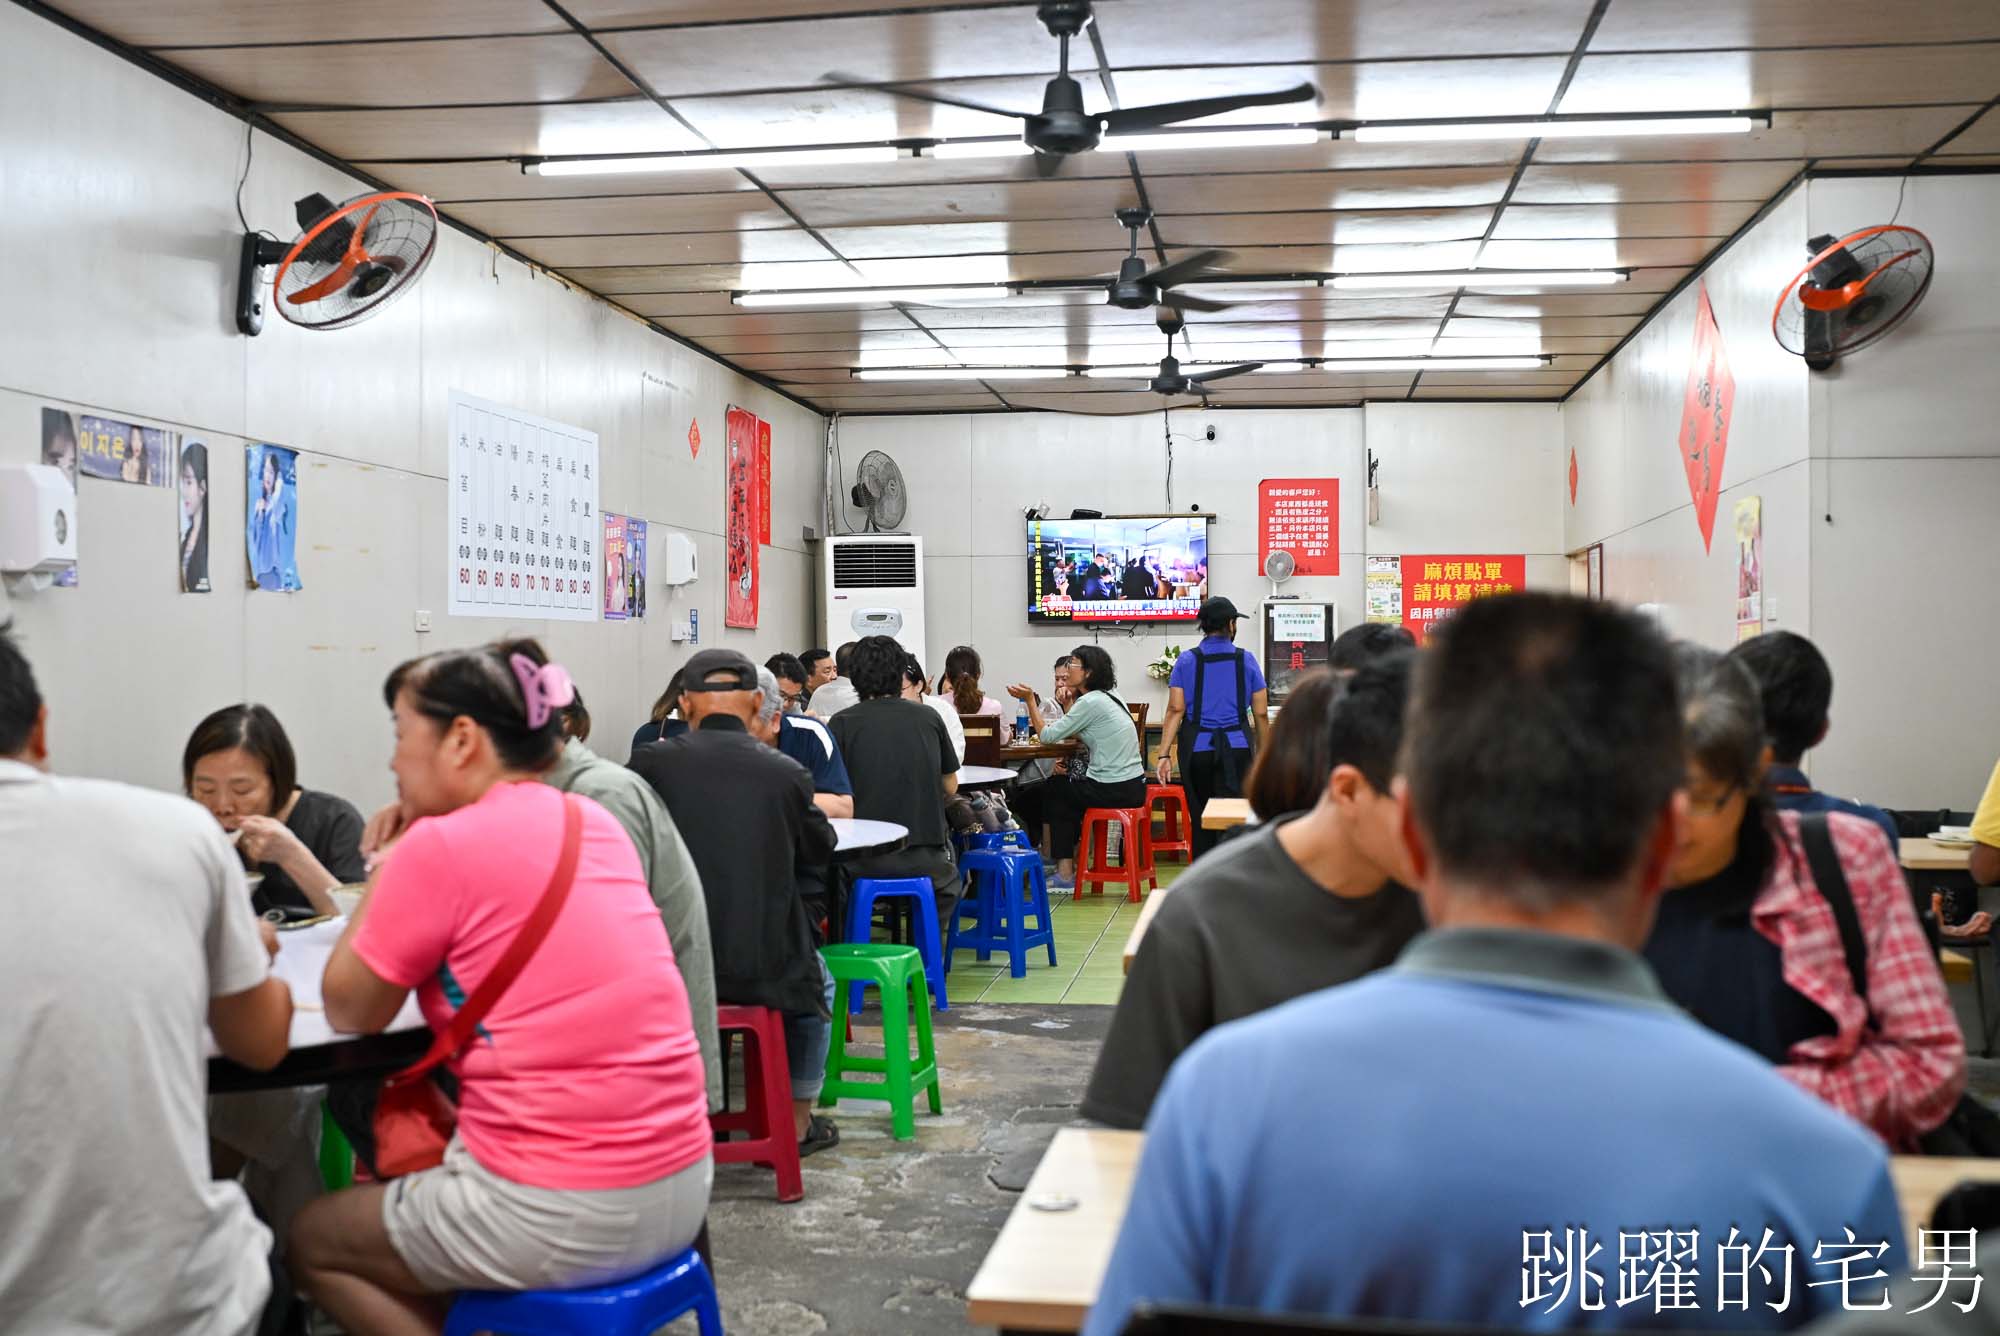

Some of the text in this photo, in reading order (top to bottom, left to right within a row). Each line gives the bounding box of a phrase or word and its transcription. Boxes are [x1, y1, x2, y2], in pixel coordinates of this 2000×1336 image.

[79, 430, 125, 460] 이지은
[458, 567, 471, 585] 60
[477, 569, 488, 586] 60
[494, 572, 504, 588] 60
[1423, 562, 1503, 581] 麻煩點單
[510, 573, 520, 589] 60
[526, 574, 536, 591] 70
[541, 576, 551, 592] 70
[582, 579, 591, 596] 90
